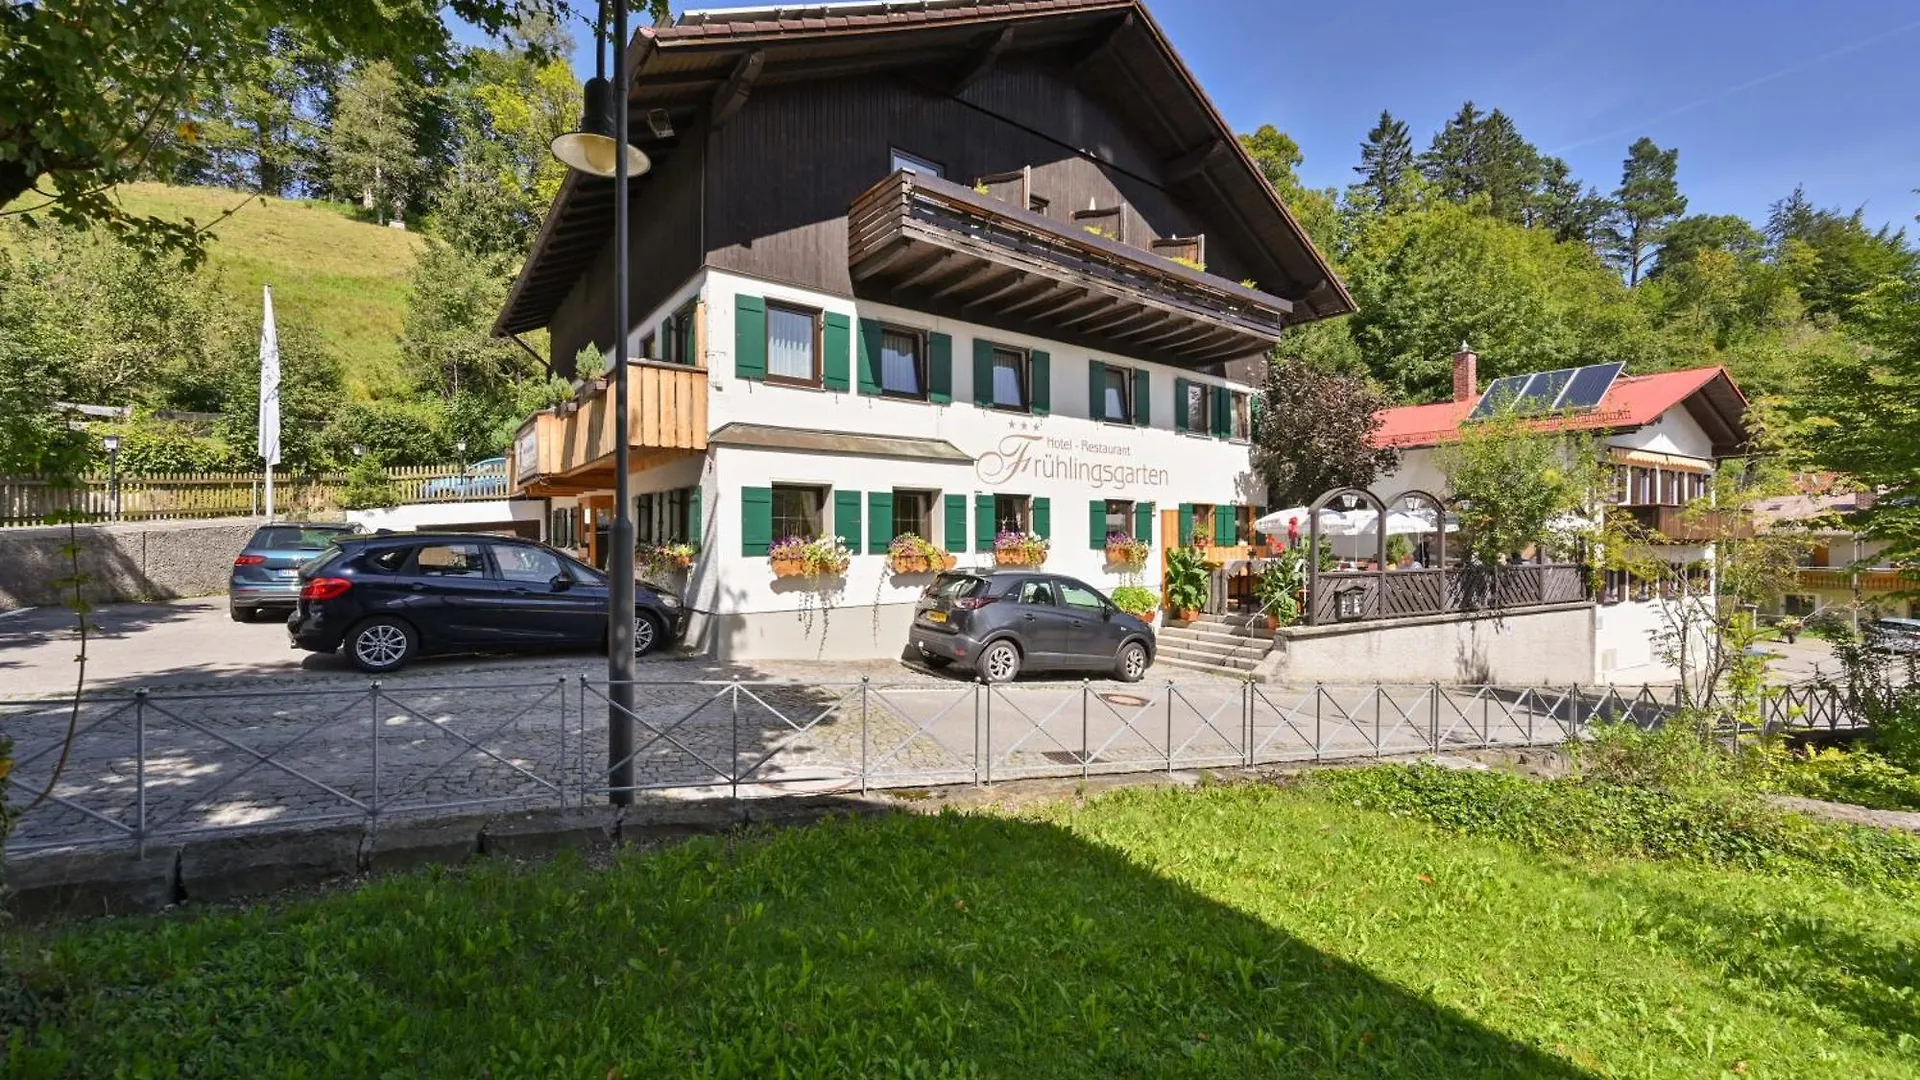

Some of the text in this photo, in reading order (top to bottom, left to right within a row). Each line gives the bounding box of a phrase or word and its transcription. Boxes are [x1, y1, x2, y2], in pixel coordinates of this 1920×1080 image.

[976, 434, 1169, 490] Frühlingsgarten
[1046, 437, 1073, 450] Hotel
[1080, 439, 1131, 456] Restaurant
